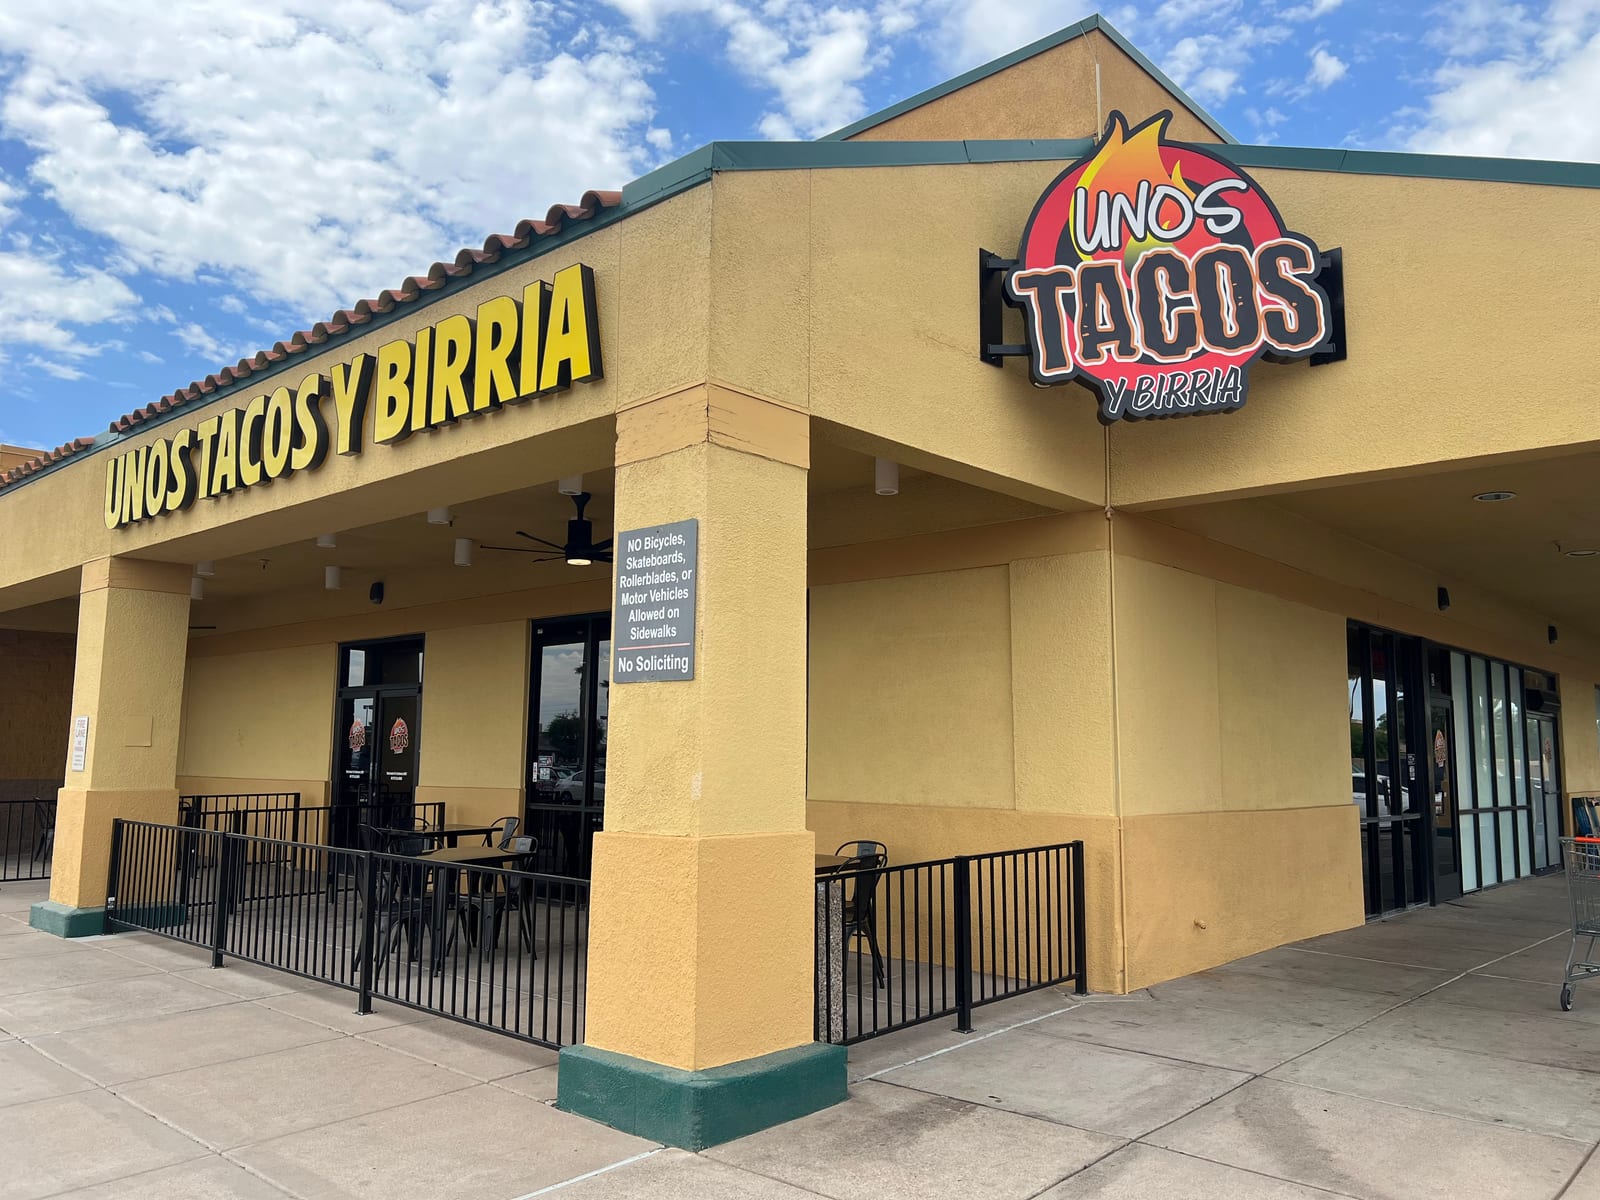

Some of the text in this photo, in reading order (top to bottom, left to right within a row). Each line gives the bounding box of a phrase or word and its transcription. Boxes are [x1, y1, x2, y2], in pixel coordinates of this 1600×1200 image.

[1074, 178, 1249, 255] UNOS
[1012, 237, 1326, 376] TACOS
[104, 263, 604, 529] UNOS TACOS Y BIRRIA
[1104, 366, 1243, 413] Y BIRRIA
[627, 533, 686, 552] NO Bicycles,
[626, 551, 686, 570] Skateboards,
[620, 569, 692, 588] Rollerblades, or
[622, 587, 688, 606] Motor Vehicles
[628, 607, 679, 622] Allowed on
[630, 625, 677, 640] Sidewalks
[618, 655, 689, 673] No Soliciting
